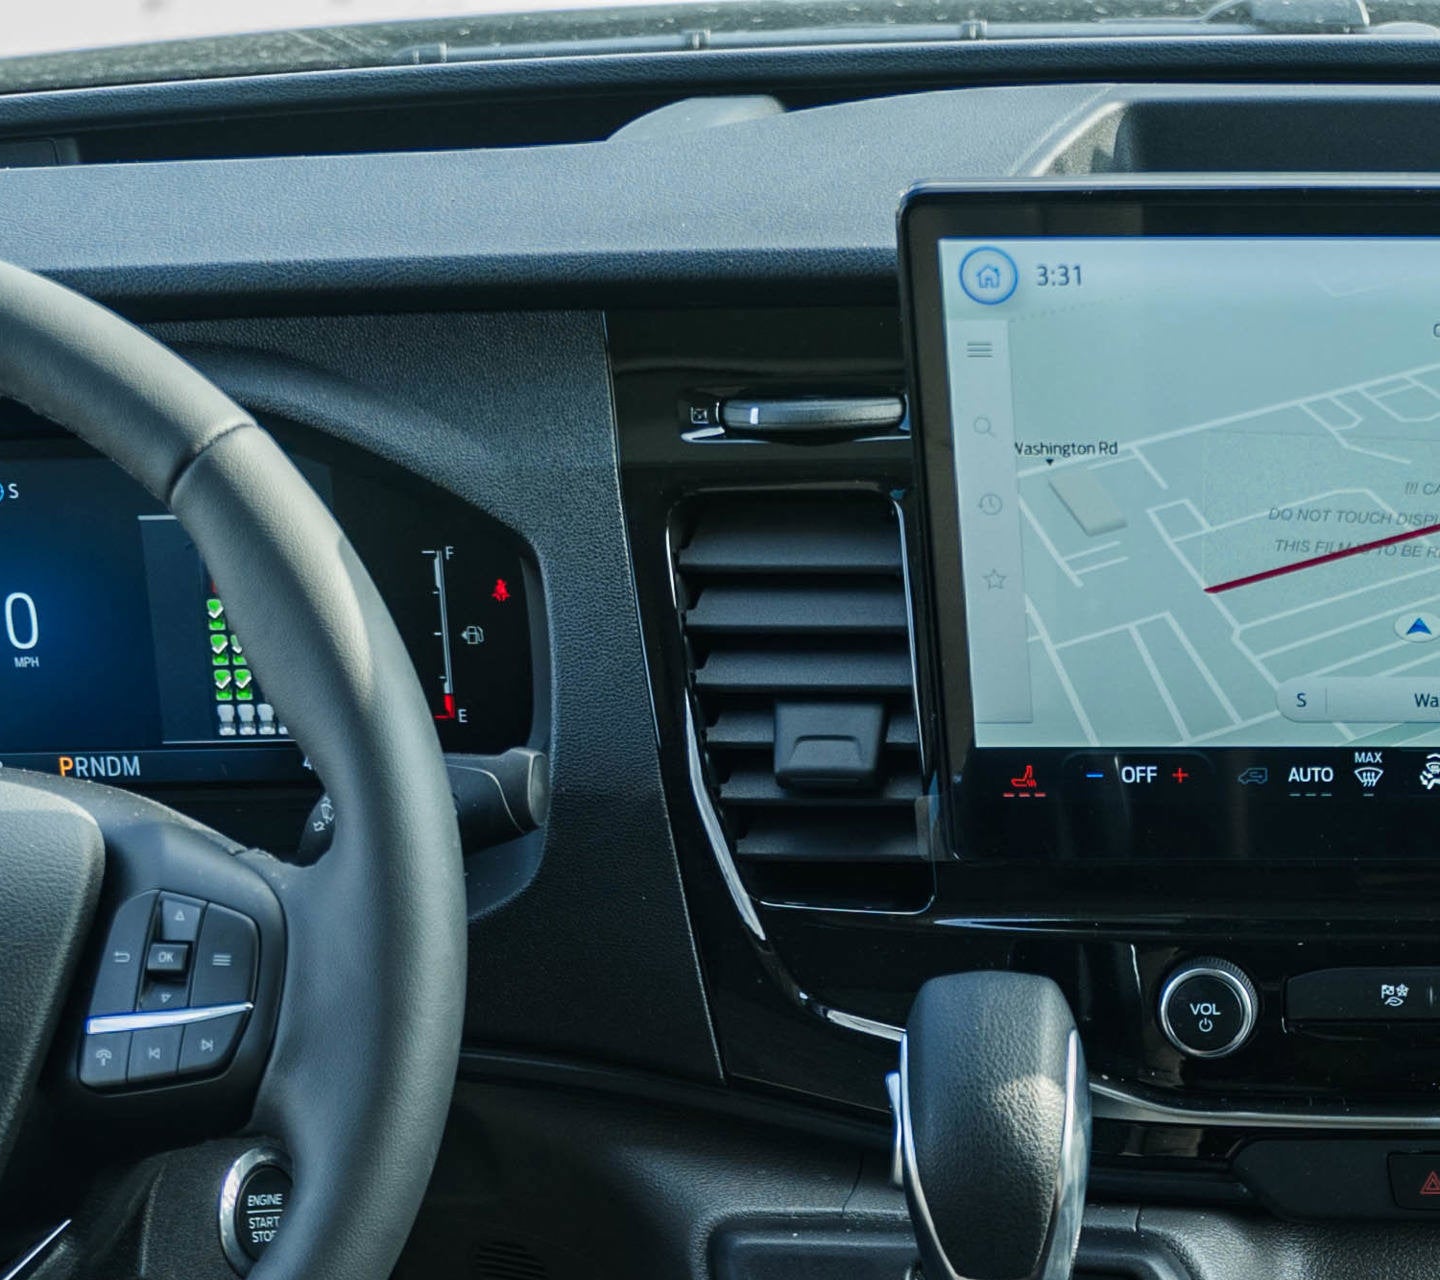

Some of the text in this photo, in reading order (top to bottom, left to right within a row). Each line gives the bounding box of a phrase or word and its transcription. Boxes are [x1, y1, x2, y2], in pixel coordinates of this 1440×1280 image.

[1036, 264, 1082, 286] 3:31
[1099, 441, 1118, 455] Rd
[7, 483, 19, 499] S
[1268, 507, 1293, 521] DO
[1296, 508, 1332, 522] NOT
[1338, 511, 1392, 525] TOUCH
[445, 546, 455, 560] F
[1275, 539, 1310, 553] THIS
[1401, 544, 1423, 558] BE
[4, 591, 40, 650] 0
[14, 657, 40, 668] MPH
[1296, 693, 1307, 708] S
[458, 709, 468, 723] E
[1354, 752, 1383, 764] MAX
[1121, 766, 1158, 784] OFF
[1288, 767, 1334, 783] AUTO
[158, 951, 174, 963] OK
[1189, 1003, 1221, 1016] VOL
[247, 1193, 283, 1207] ENGINE
[248, 1216, 280, 1230] START
